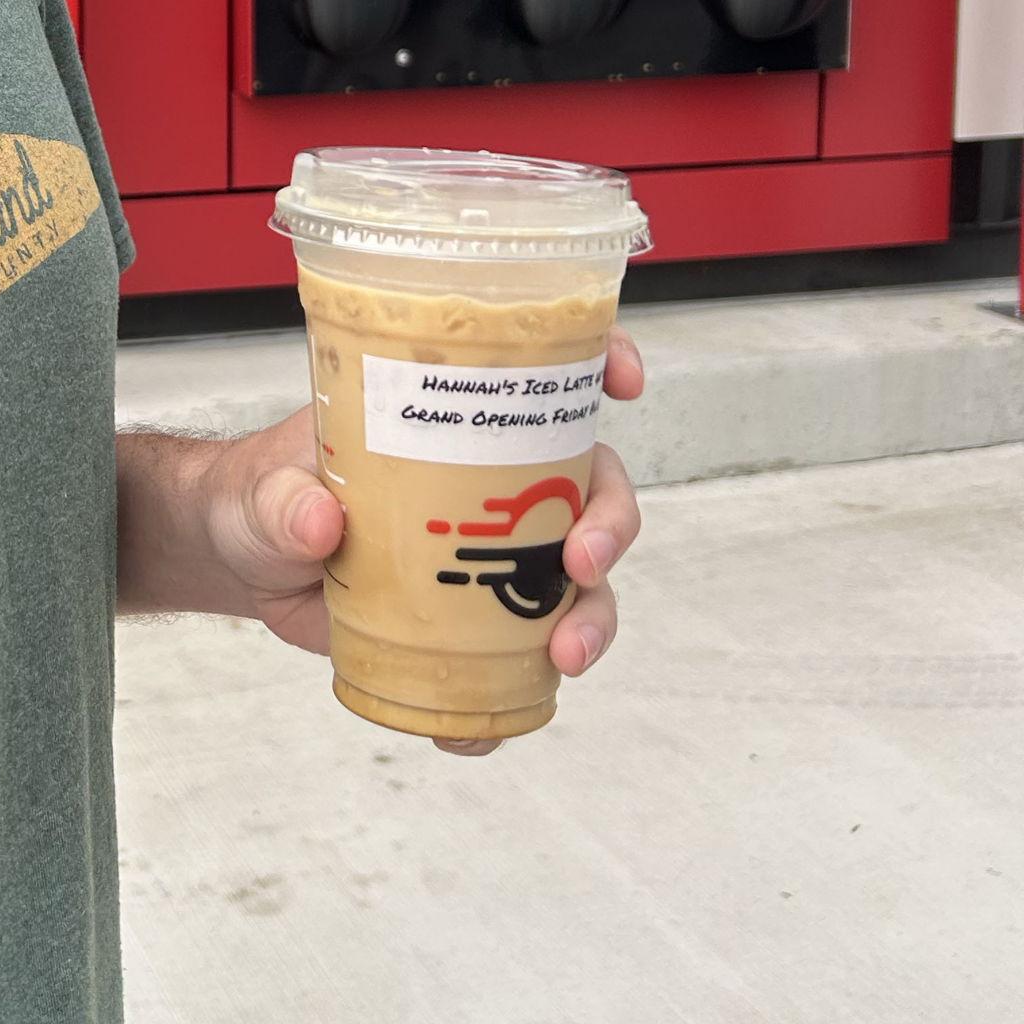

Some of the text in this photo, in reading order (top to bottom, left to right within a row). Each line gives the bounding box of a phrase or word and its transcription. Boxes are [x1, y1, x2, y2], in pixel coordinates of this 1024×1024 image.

[421, 374, 518, 396] HANNAH'S
[521, 378, 559, 396] ICED
[401, 404, 464, 425] GRAND
[472, 409, 547, 427] OPENING
